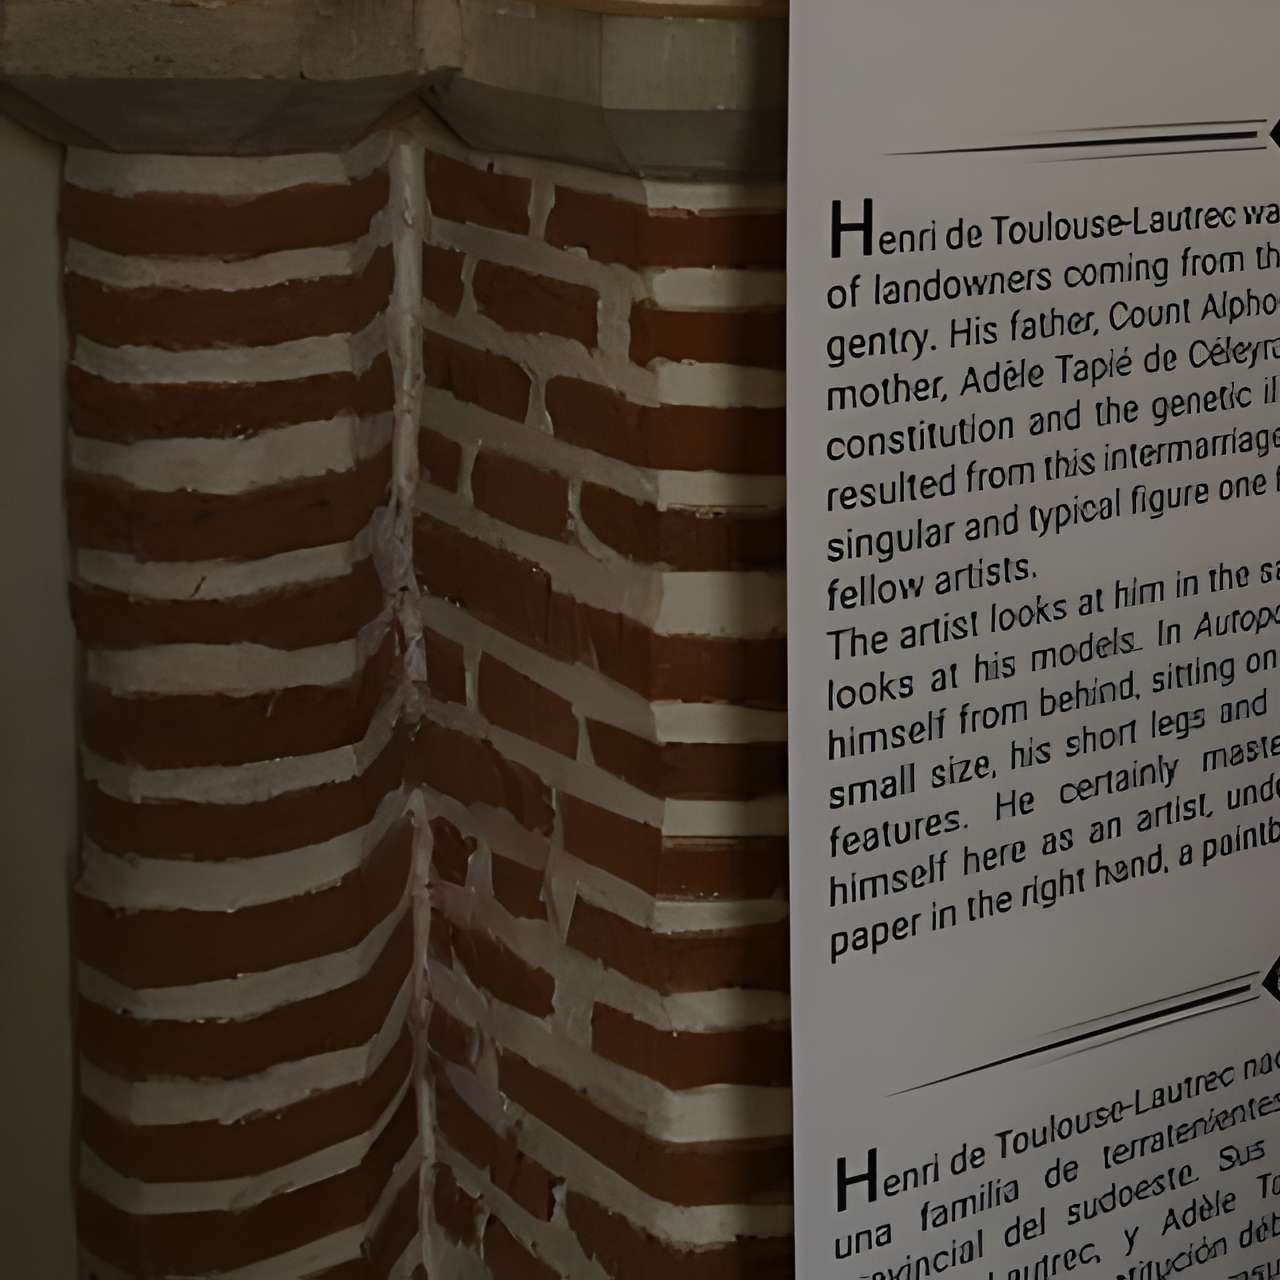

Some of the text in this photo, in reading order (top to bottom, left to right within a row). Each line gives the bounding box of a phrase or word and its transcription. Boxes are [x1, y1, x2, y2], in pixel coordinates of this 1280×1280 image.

[831, 197, 936, 259] Henri
[945, 217, 983, 250] de
[989, 206, 1237, 245] Toulouse-Lautrec
[827, 273, 861, 310] of
[874, 267, 1052, 305] landowners
[1063, 252, 1169, 288] coming
[1181, 246, 1245, 277] from
[826, 327, 937, 369] gentry.
[950, 316, 998, 349] His
[1109, 298, 1191, 331] Count
[827, 372, 948, 411] mother,
[1143, 343, 1177, 374] de
[826, 412, 1014, 461] constitution
[1029, 399, 1081, 436] and
[1095, 396, 1139, 427] the
[1151, 381, 1253, 427] genetic
[827, 463, 956, 512] resulted
[966, 459, 1035, 493] from
[1044, 447, 1096, 481] this
[827, 517, 956, 564] singular
[964, 503, 1019, 542] and
[1131, 482, 1209, 520] figure
[1218, 473, 1267, 501] one
[826, 576, 1165, 661] The artist looks at him
[827, 557, 1037, 612] fellow artists.
[828, 619, 1181, 712] looks at his In
[959, 700, 1028, 735] from
[1245, 648, 1277, 674] on
[829, 762, 915, 810] small
[931, 755, 997, 789] size,
[1010, 736, 1051, 770] his
[830, 810, 968, 858] features.
[996, 789, 1035, 821] He
[963, 840, 1026, 876] here
[1041, 828, 1074, 856] as
[1088, 816, 1122, 844] an
[831, 912, 922, 965] paper
[932, 901, 957, 931] in
[967, 889, 1013, 922] the
[1021, 867, 1085, 909] right
[835, 1223, 892, 1260] una
[1044, 1157, 1079, 1189] de
[836, 1142, 986, 1213] Henri de
[1004, 1206, 1046, 1248] del
